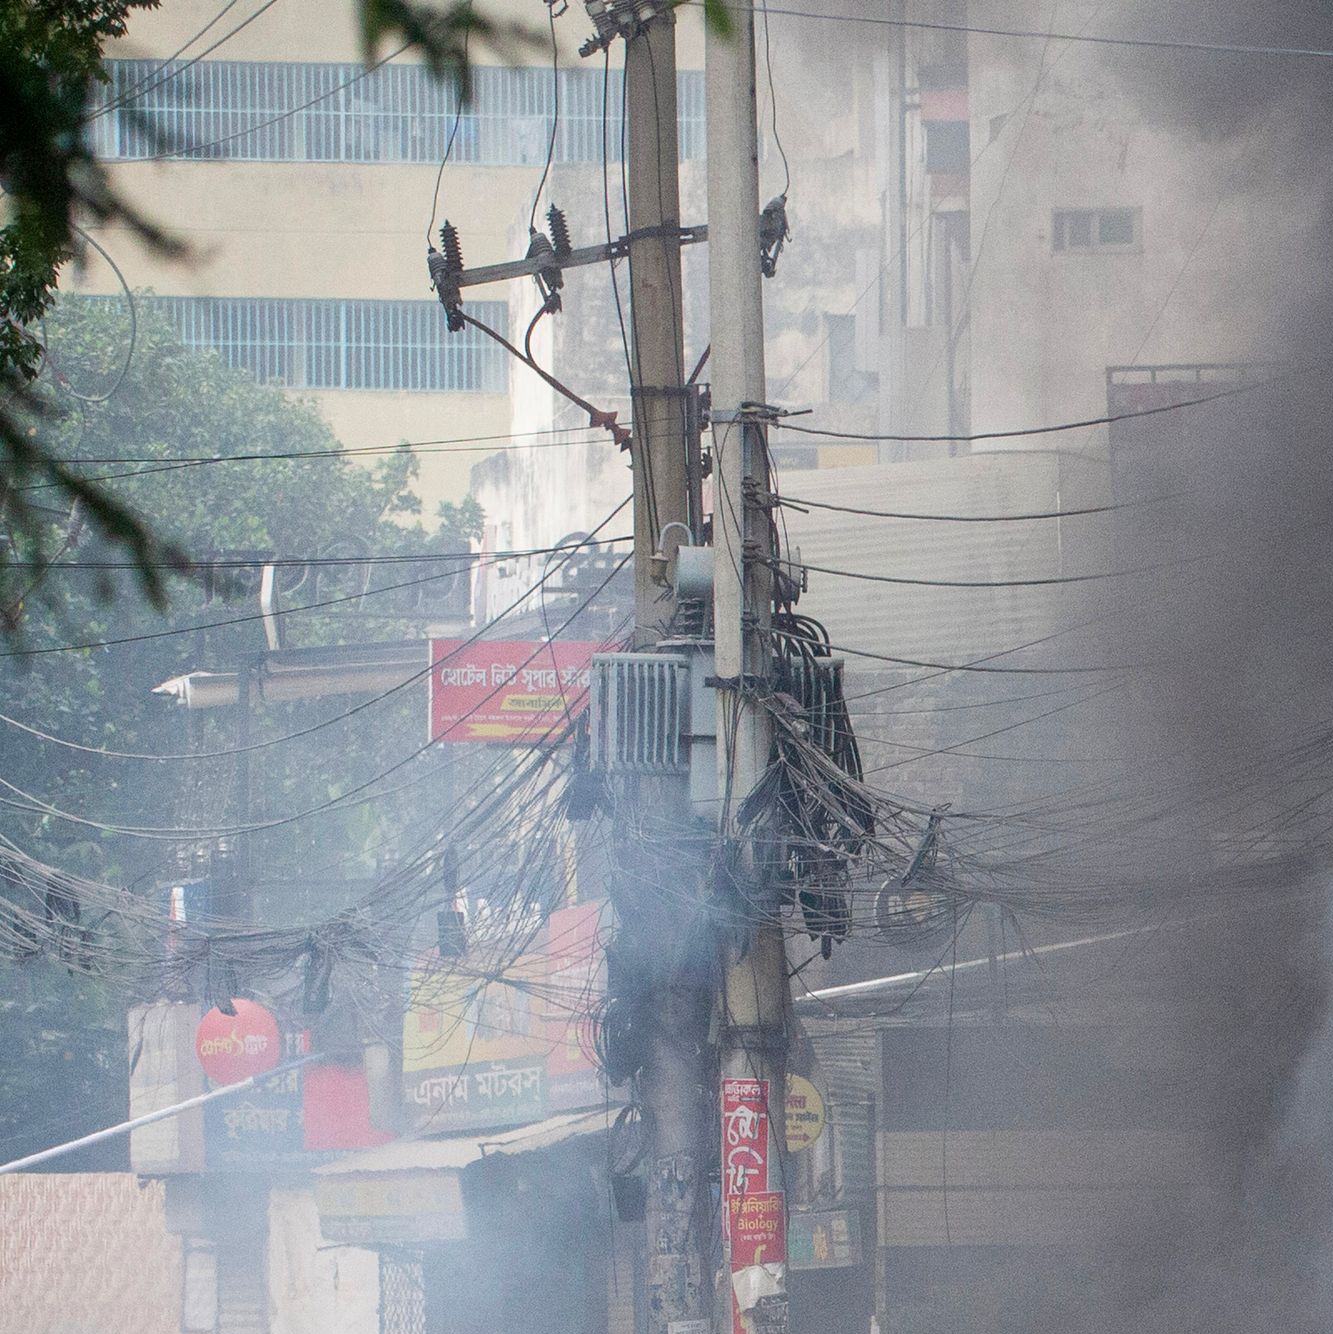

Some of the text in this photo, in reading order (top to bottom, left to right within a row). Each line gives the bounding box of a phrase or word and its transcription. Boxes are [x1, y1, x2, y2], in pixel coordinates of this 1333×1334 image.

[441, 664, 487, 688] হোটেল
[491, 663, 518, 688] নিউ
[522, 667, 557, 692] সুপার
[413, 1074, 469, 1106] এনাম
[737, 1218, 778, 1232] Biology
